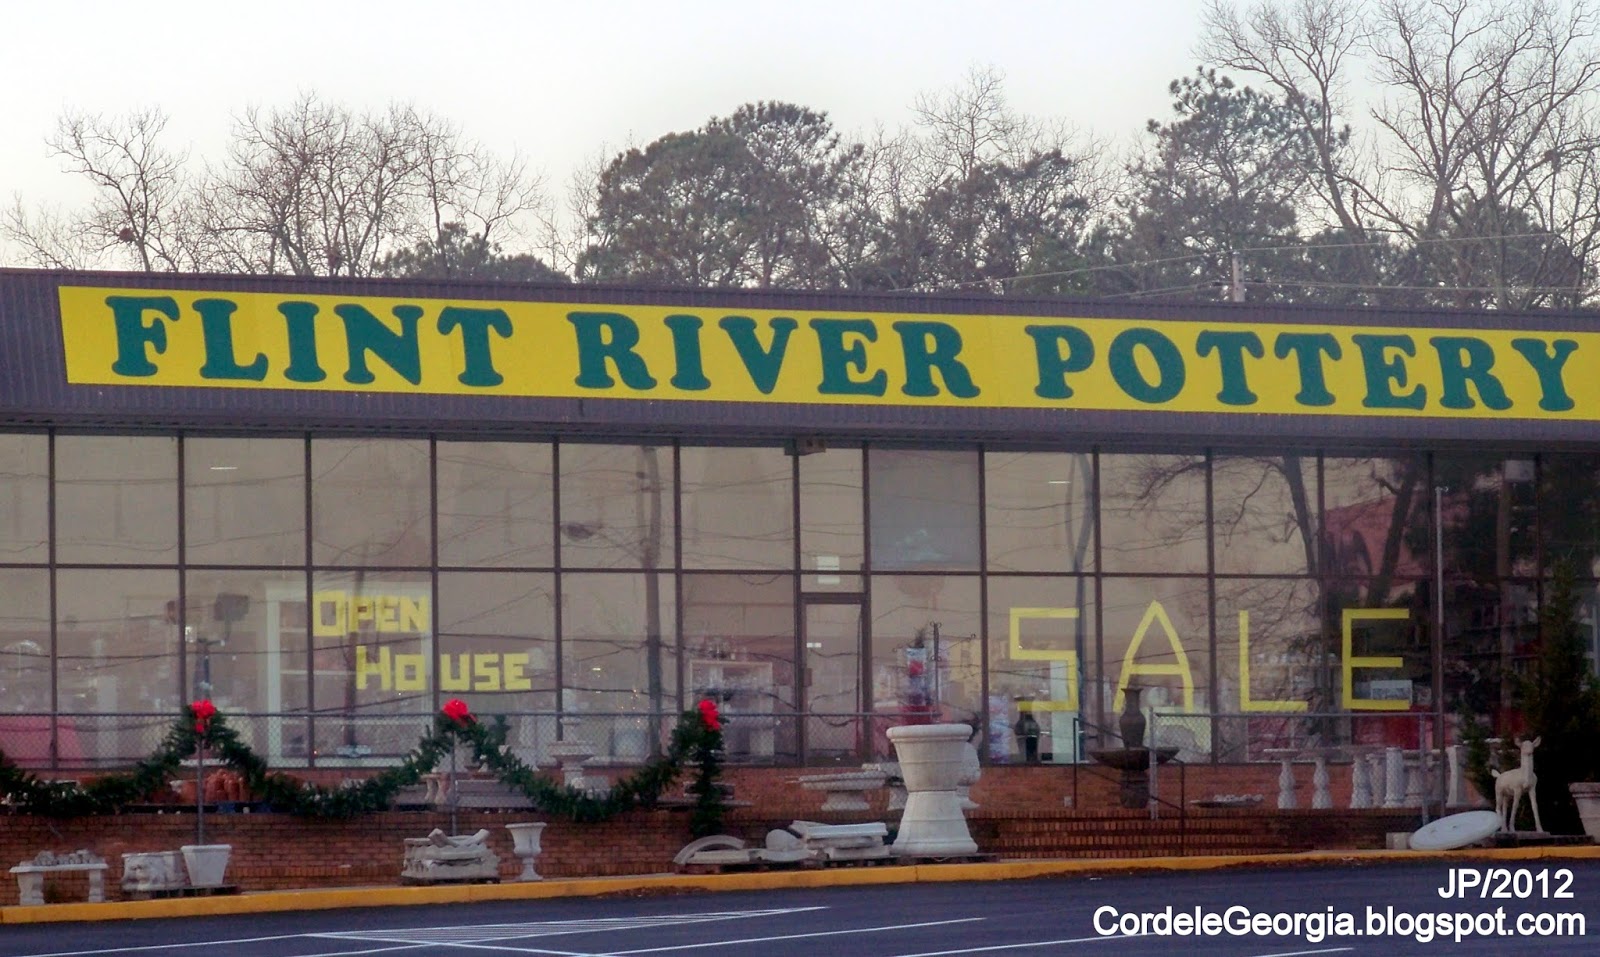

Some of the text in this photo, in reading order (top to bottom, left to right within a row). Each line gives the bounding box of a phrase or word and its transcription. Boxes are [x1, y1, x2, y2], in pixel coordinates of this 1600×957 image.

[105, 296, 1579, 412] FLINT RIVER POTTERY
[313, 591, 429, 637] OPEN
[356, 645, 531, 691] HOUSE
[1009, 600, 1411, 713] SALE
